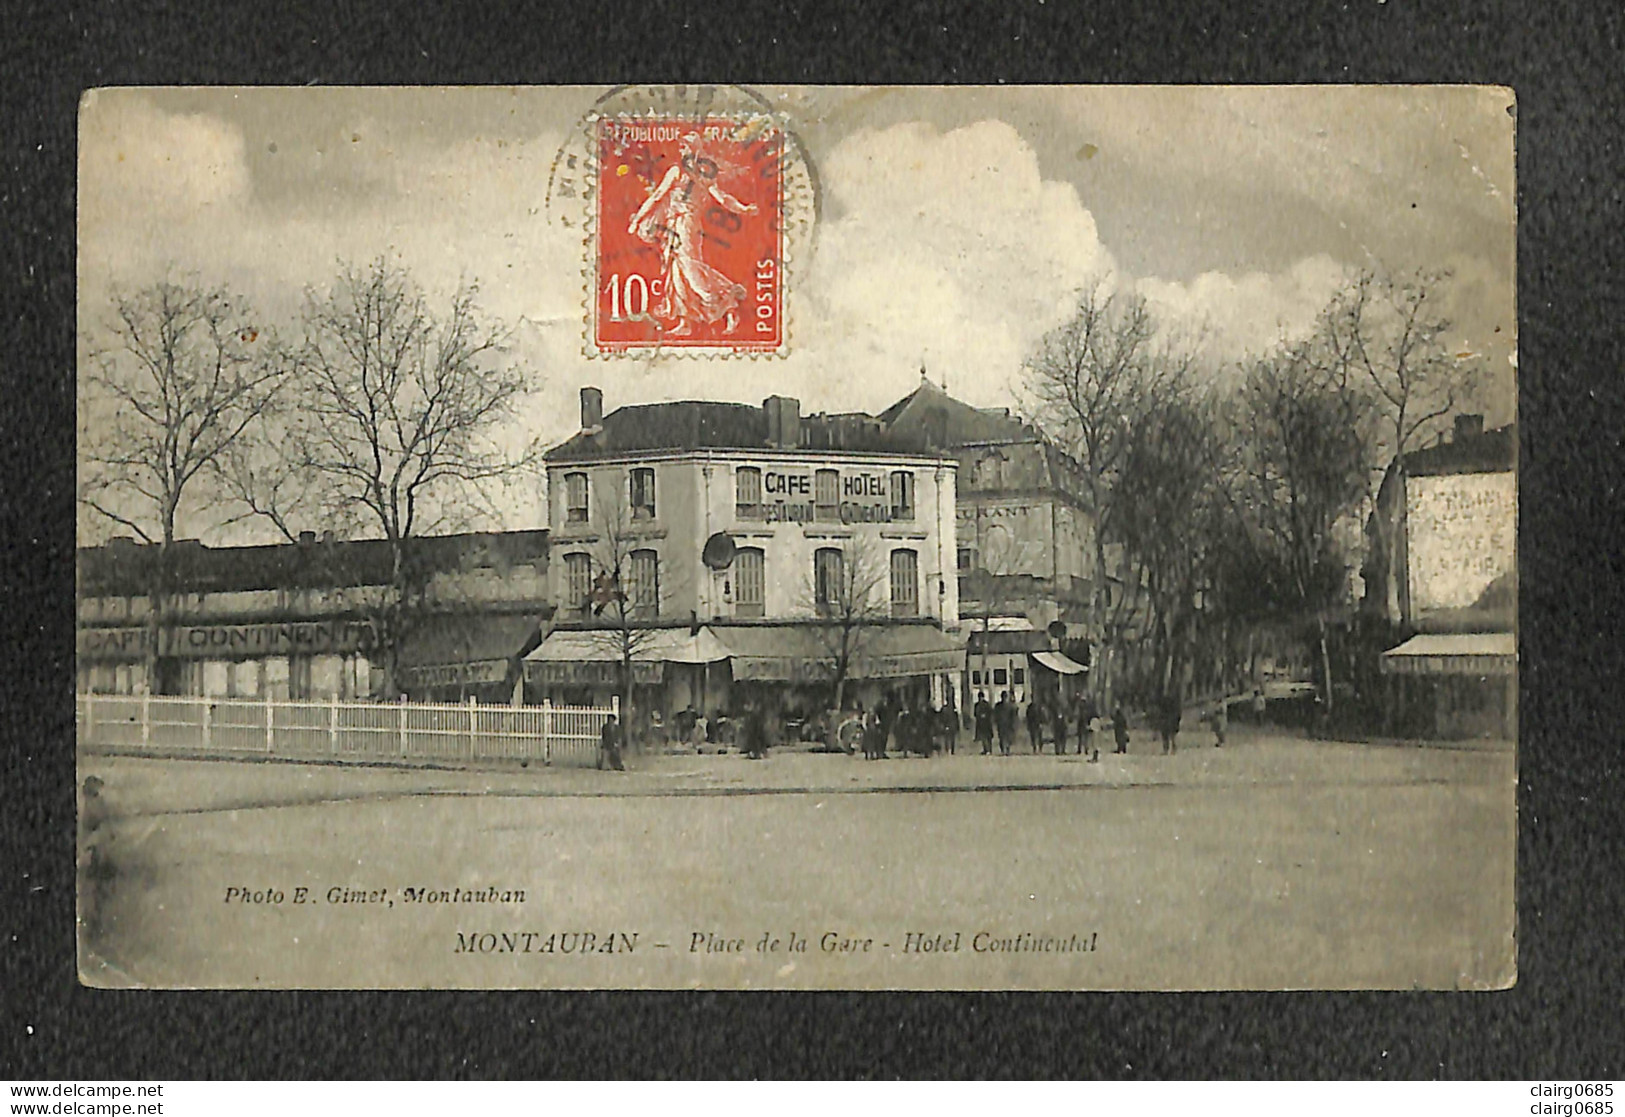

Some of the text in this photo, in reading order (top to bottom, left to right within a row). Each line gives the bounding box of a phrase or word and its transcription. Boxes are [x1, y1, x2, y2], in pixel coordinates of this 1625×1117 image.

[756, 258, 774, 333] POSTES
[765, 472, 886, 497] CAFE HOTEL
[224, 887, 285, 904] Photo
[404, 886, 528, 904] Montauban
[453, 932, 640, 954] MONTAUBAN
[689, 931, 745, 953] Place
[756, 931, 780, 953] de
[788, 931, 808, 953] la
[820, 932, 873, 953] Gare
[902, 931, 961, 953] Hotel
[973, 931, 1098, 953] Continental
